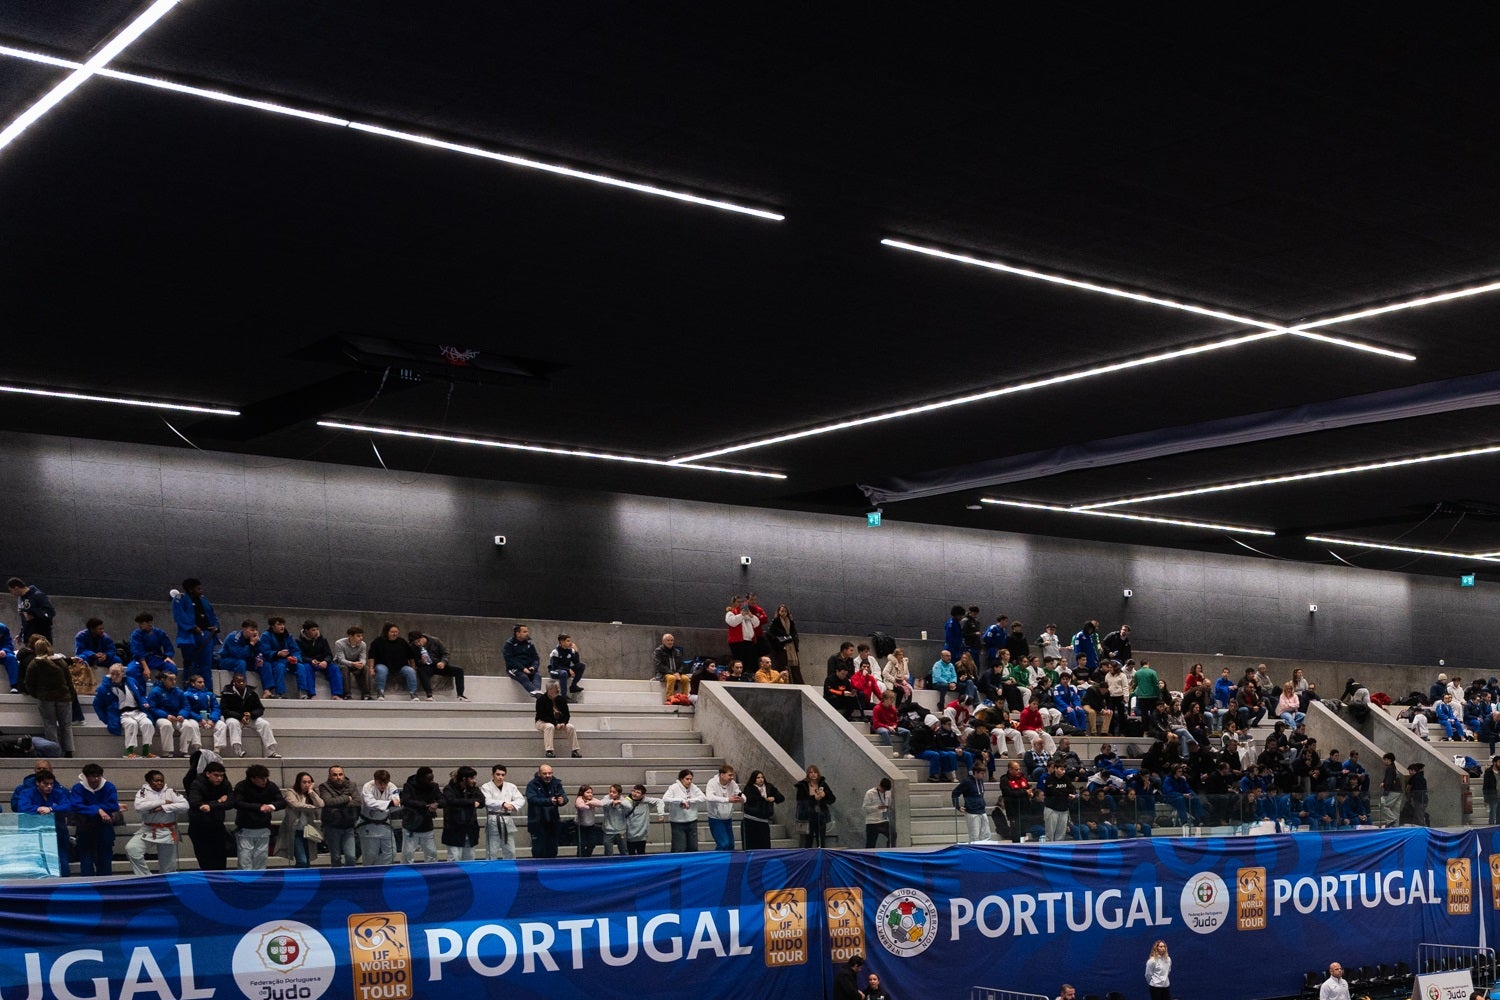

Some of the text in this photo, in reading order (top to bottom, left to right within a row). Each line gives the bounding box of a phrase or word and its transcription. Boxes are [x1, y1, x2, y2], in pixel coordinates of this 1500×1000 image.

[897, 889, 917, 897] JUDO
[1273, 869, 1441, 916] PORTUGAL
[1450, 895, 1470, 903] JUDO
[949, 886, 1172, 941] PORTUGAL
[1240, 908, 1263, 918] JUDO
[1450, 904, 1470, 912] TOUR
[922, 899, 938, 950] FEDERATION
[1194, 916, 1217, 928] Judo
[1240, 918, 1263, 928] TOUR
[770, 929, 803, 938] WORLD
[830, 927, 861, 936] WORLD
[876, 900, 904, 956] INTERNATIONAL
[424, 908, 753, 981] PORTUGAL
[770, 938, 803, 951] JUDO
[373, 951, 390, 960] IJF
[770, 951, 803, 963] TOUR
[359, 960, 406, 971] WORLD
[250, 978, 284, 986] Federação
[360, 970, 406, 986] JUDO
[263, 984, 311, 1000] Judo
[360, 985, 407, 1000] TOUR
[1448, 989, 1466, 1000] Judo
